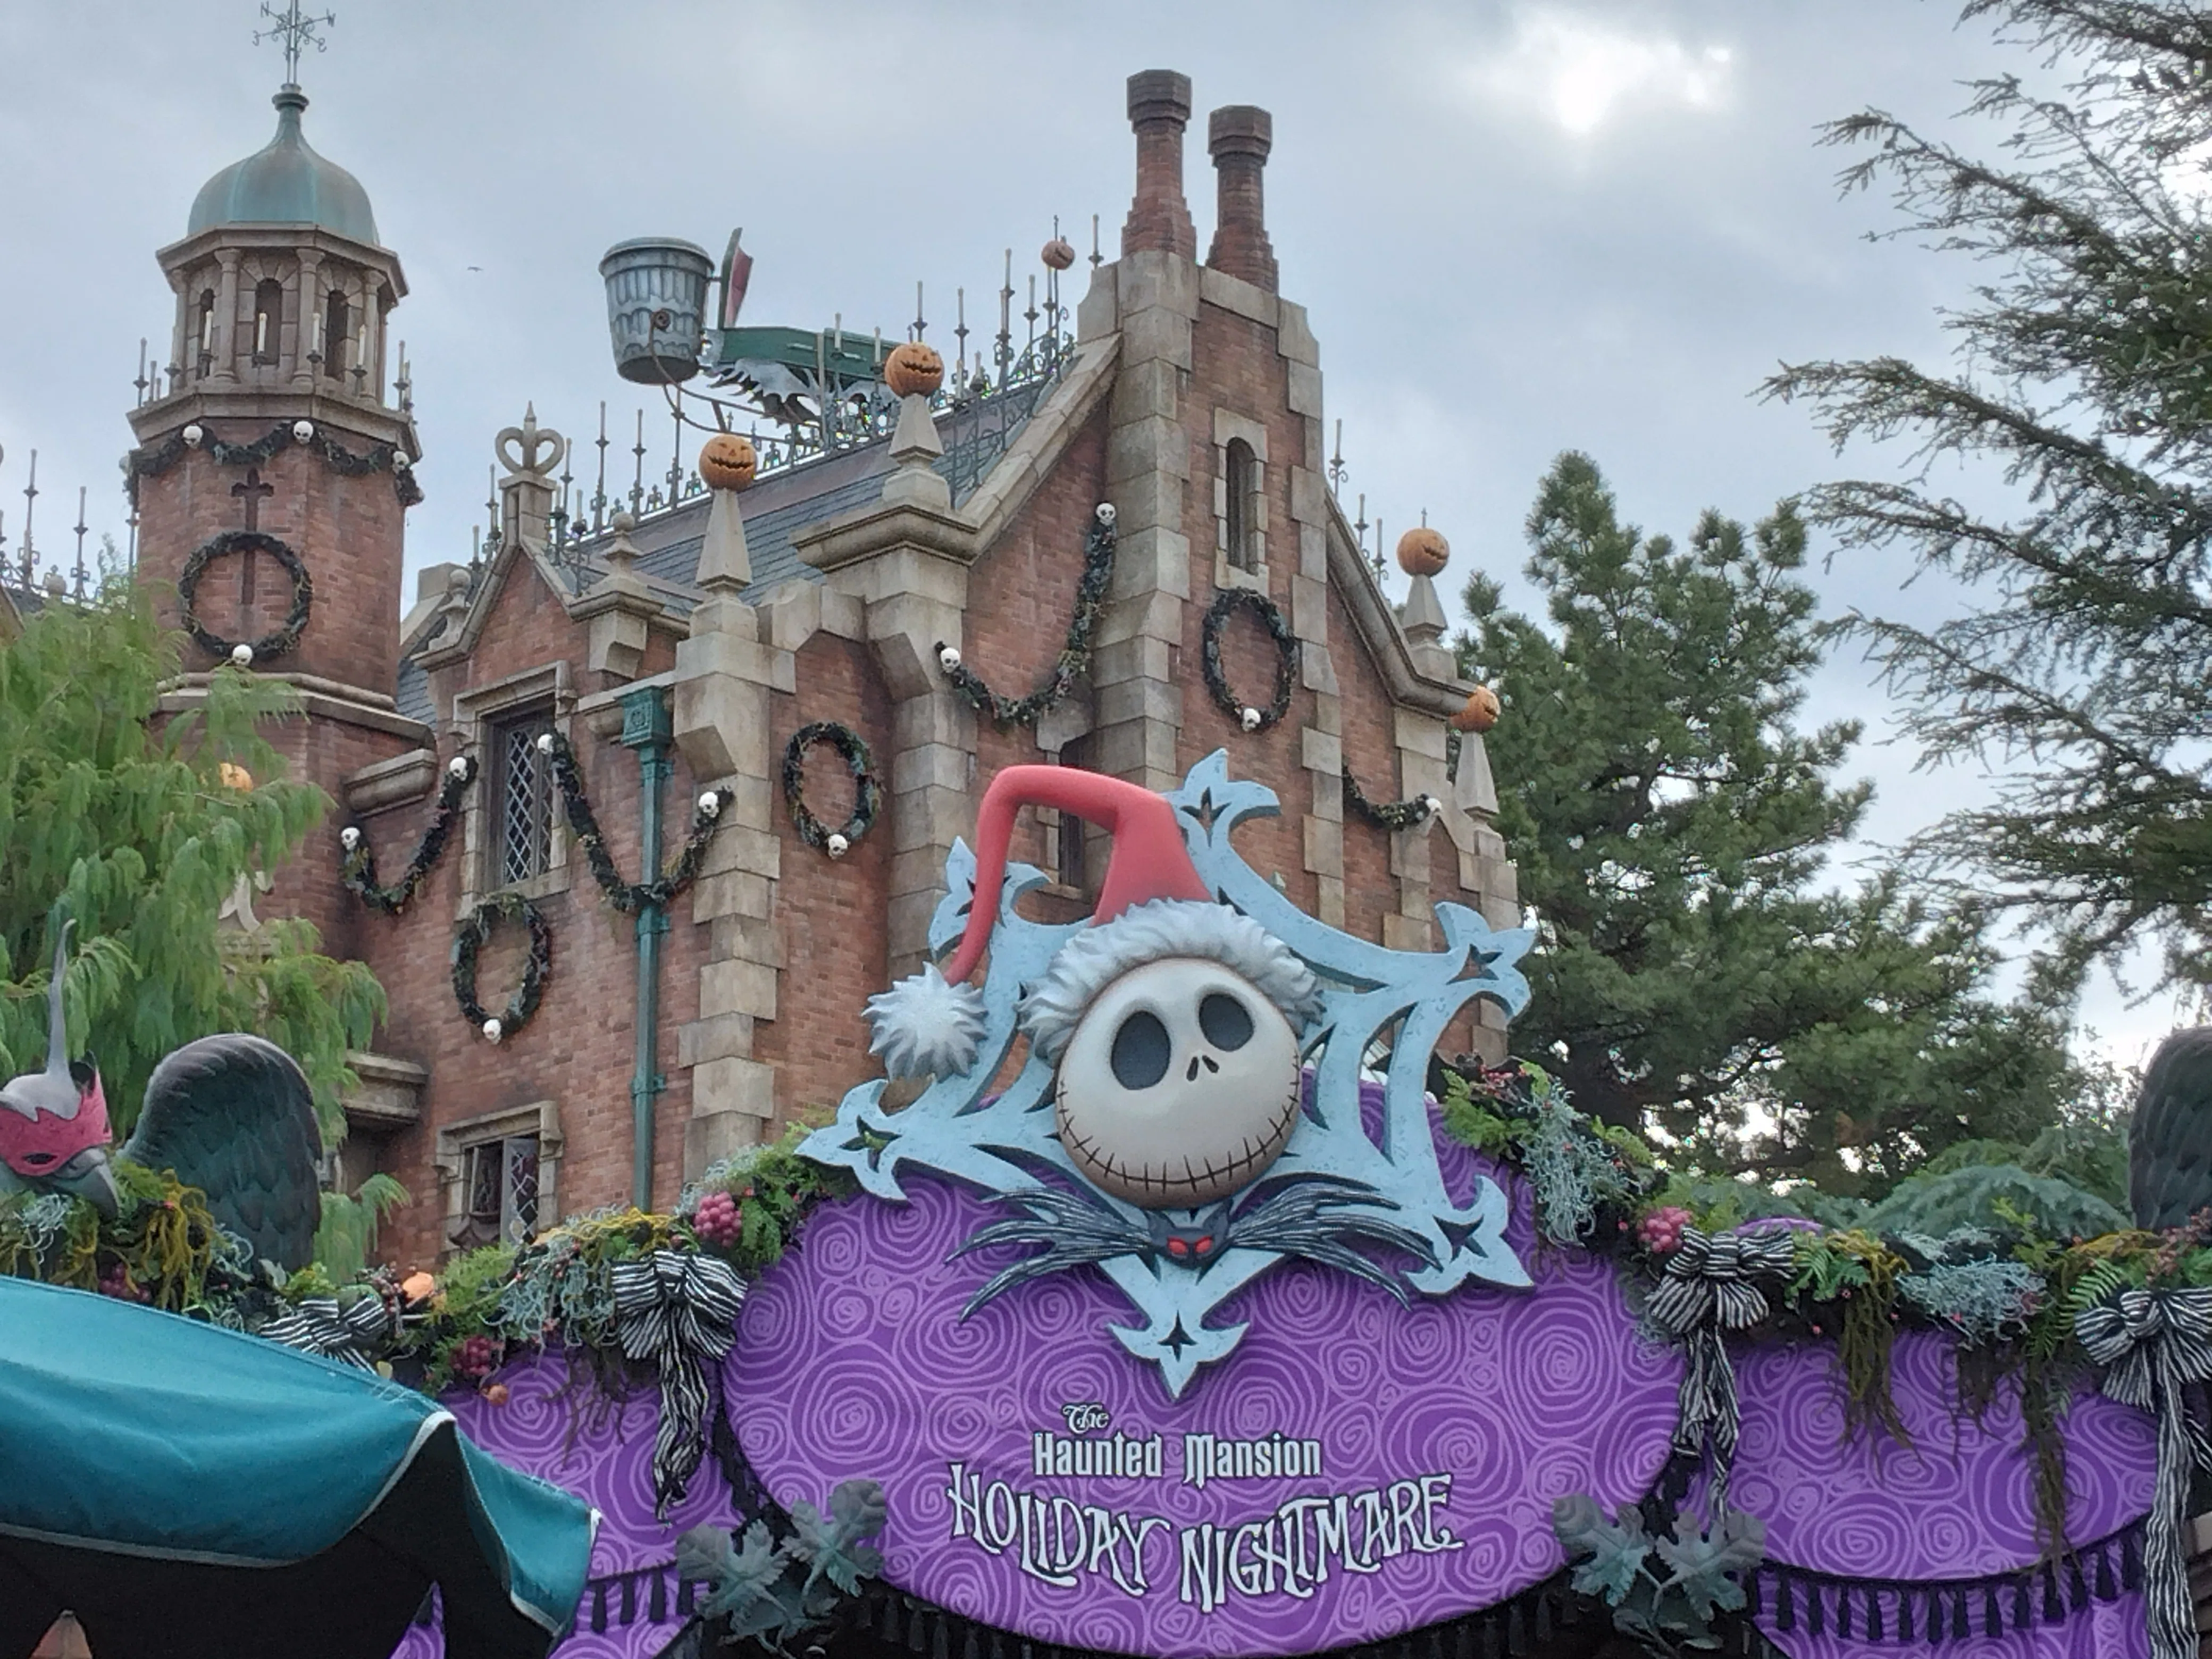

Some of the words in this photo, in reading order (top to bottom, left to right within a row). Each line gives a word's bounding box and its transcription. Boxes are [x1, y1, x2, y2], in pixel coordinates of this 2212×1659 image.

[1062, 1404, 1109, 1434] The
[1033, 1432, 1163, 1477] Haunted
[1182, 1434, 1321, 1488] Mansion
[947, 1464, 1170, 1595] HOLIDAY
[1180, 1474, 1464, 1613] NIGHTMARE
